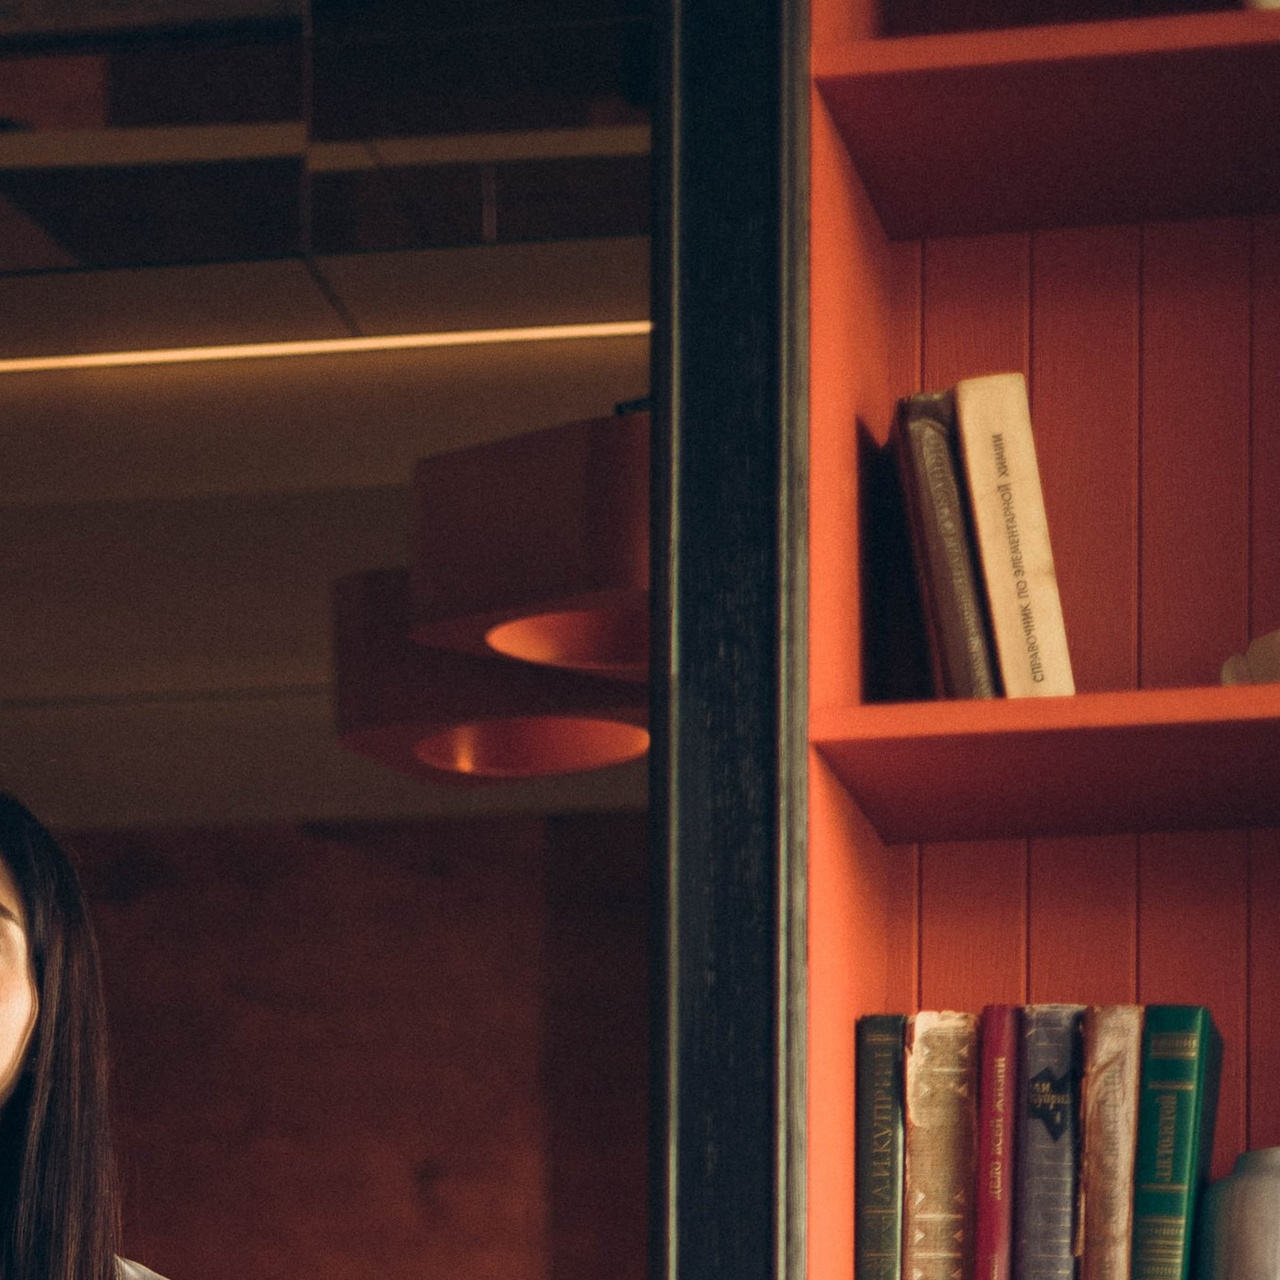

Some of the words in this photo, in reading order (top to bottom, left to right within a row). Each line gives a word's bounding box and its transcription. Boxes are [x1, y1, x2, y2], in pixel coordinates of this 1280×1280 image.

[991, 432, 1009, 477] ХИМИИ
[997, 483, 1026, 579] ЭЛЕМЕНТАРНОЙ
[1015, 580, 1027, 600] ПО
[1017, 602, 1045, 684] СПРАВОЧНИК
